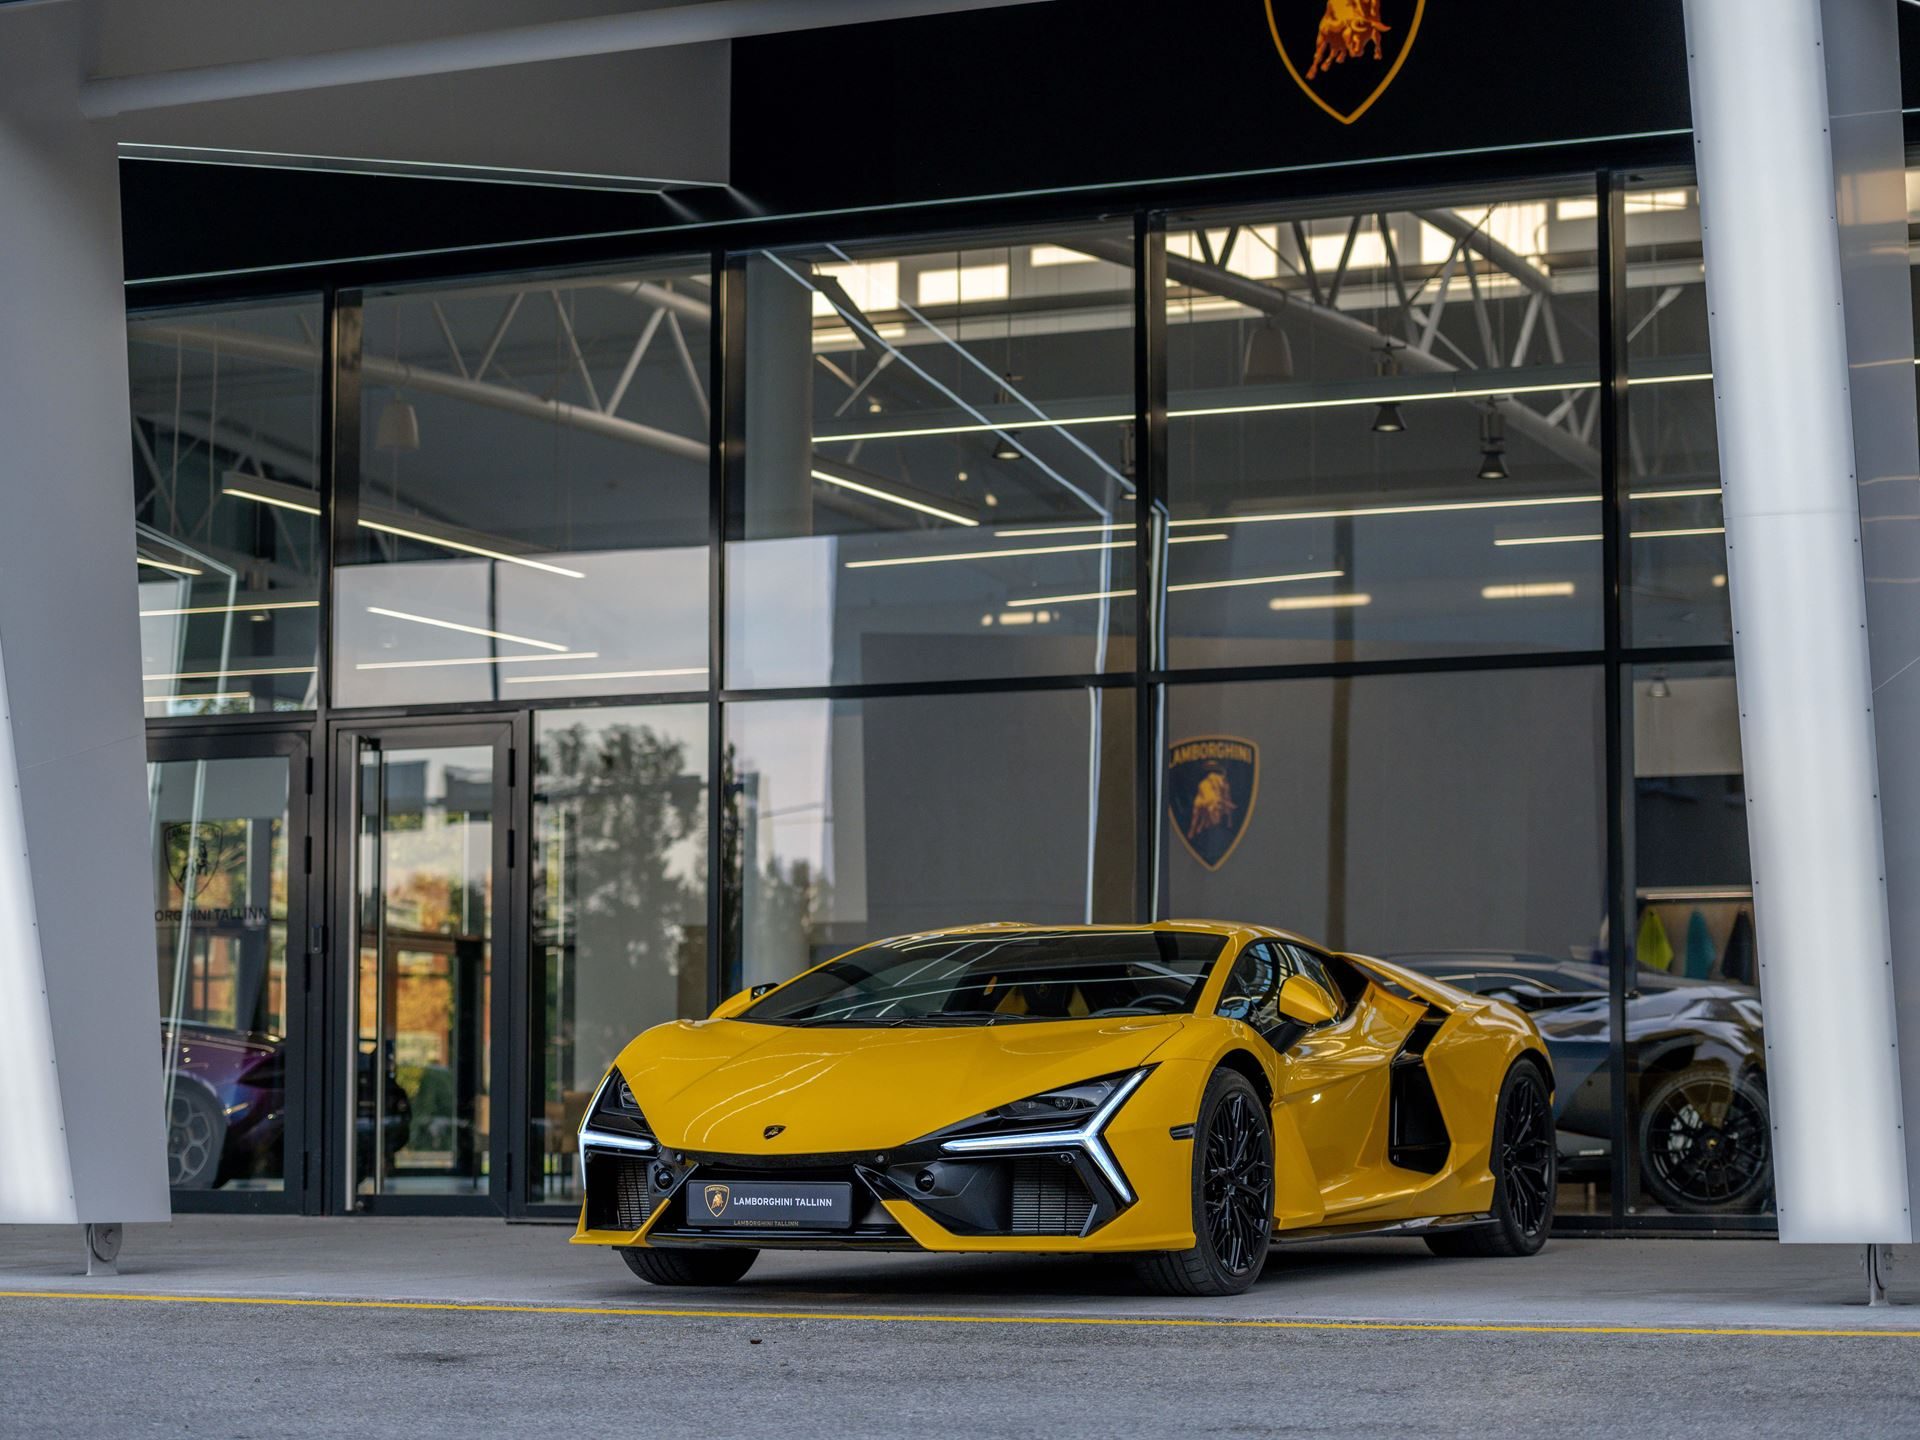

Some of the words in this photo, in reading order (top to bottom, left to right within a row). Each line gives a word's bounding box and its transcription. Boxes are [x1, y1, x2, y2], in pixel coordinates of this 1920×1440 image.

[214, 905, 268, 921] TALLINN
[733, 1197, 793, 1206] LAMBORGHINI
[795, 1198, 833, 1207] TALLINN
